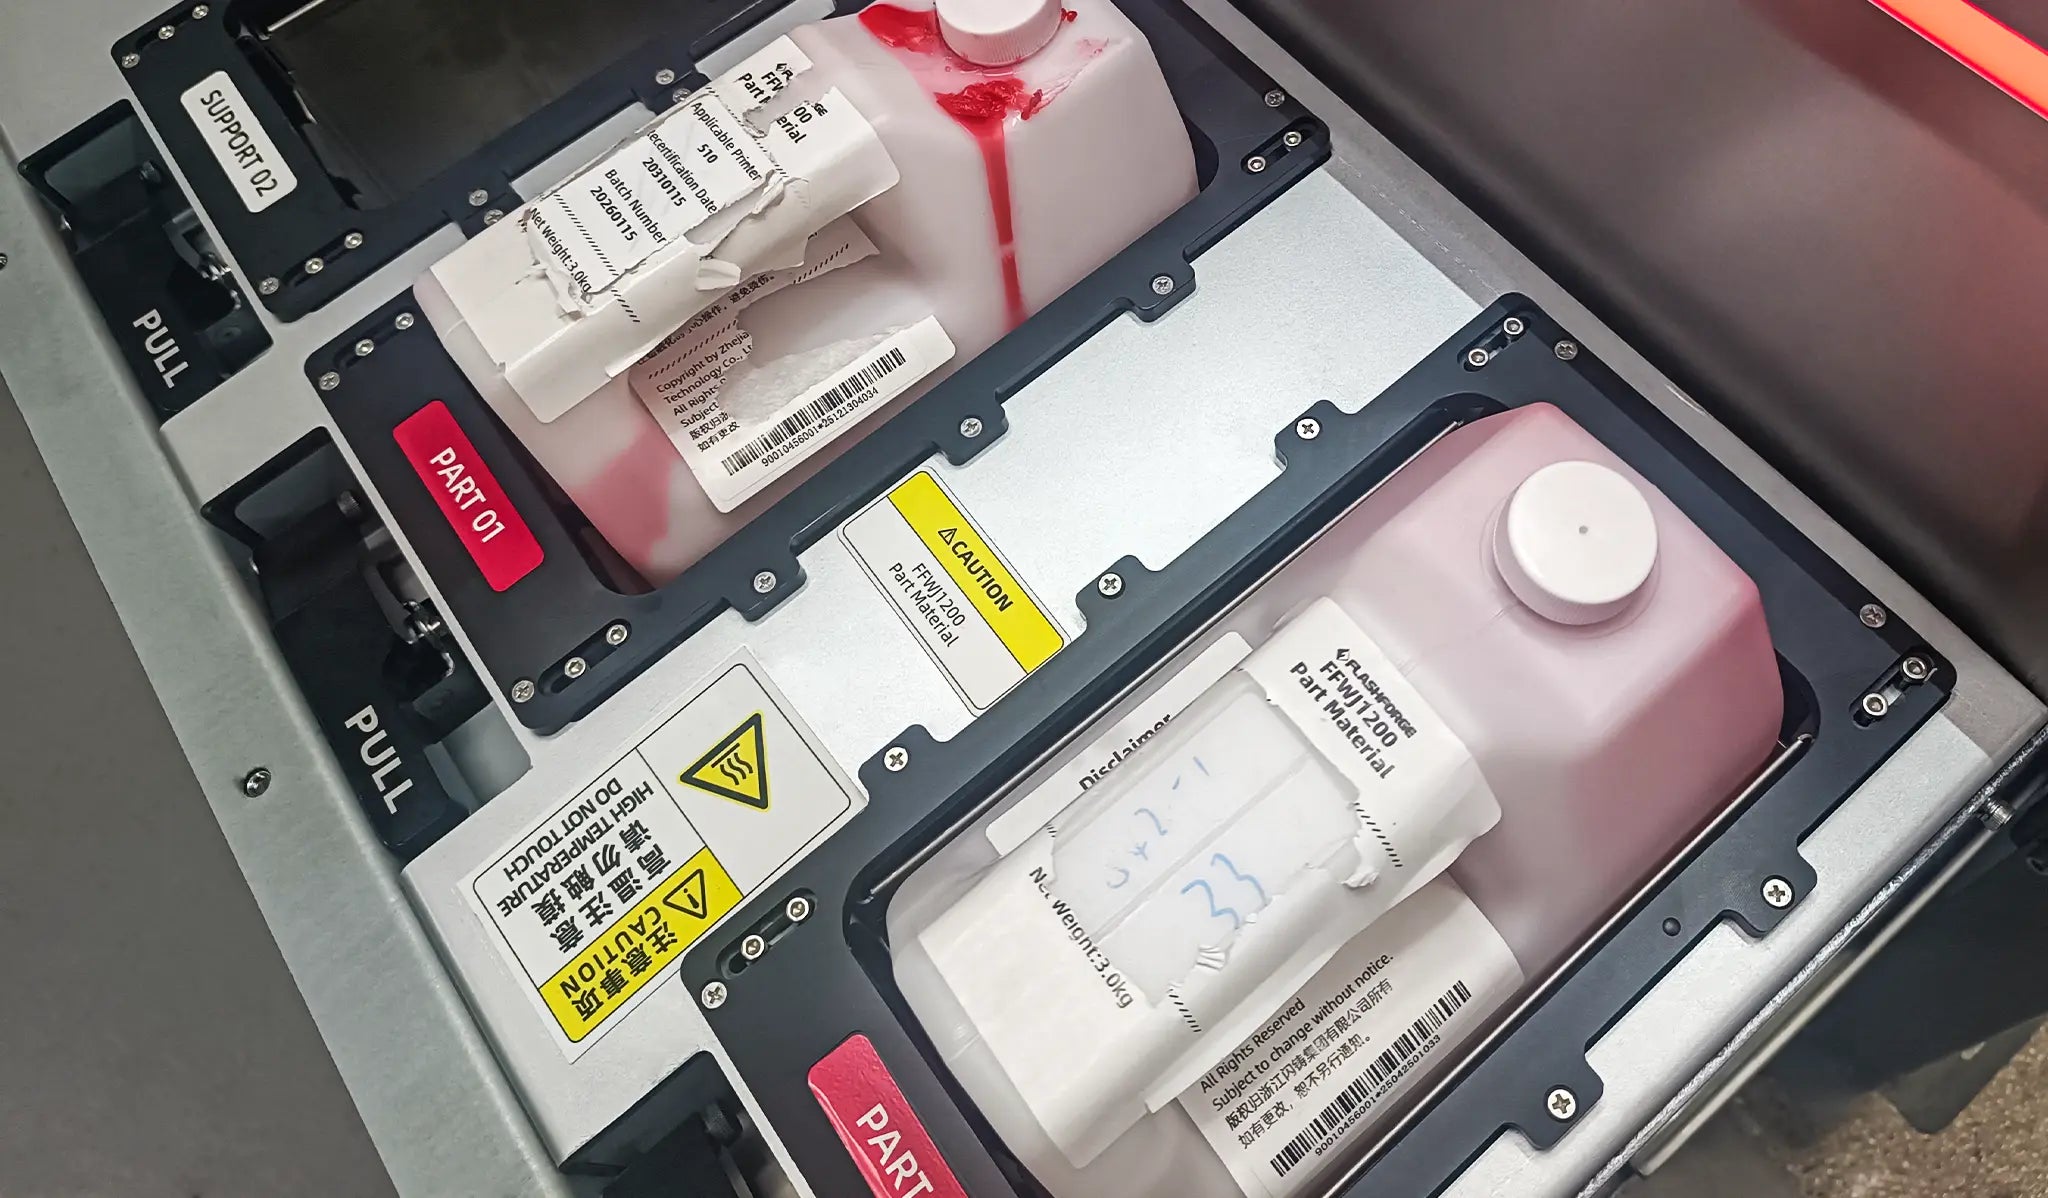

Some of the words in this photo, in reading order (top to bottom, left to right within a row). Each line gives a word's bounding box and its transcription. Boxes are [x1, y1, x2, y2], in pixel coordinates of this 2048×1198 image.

[738, 72, 765, 100] Part
[200, 89, 264, 170] SUPPORT
[250, 168, 279, 198] 02
[642, 156, 687, 208] 20310115
[690, 101, 735, 151] Applicable
[731, 146, 764, 182] Printer
[696, 143, 719, 165] 510
[530, 207, 546, 227] Net
[590, 185, 638, 243] 20260115
[604, 168, 632, 201] Batch
[628, 199, 668, 245] Number
[693, 185, 719, 215] Date
[132, 308, 189, 389] PULL
[656, 358, 706, 394] Copyright
[704, 350, 721, 369] by
[664, 365, 724, 405] Technology
[722, 353, 744, 370] Co.,
[673, 400, 692, 417] All
[680, 401, 720, 428] Subject
[429, 446, 487, 511] PART
[472, 509, 506, 543] 01
[888, 562, 915, 594] Part
[910, 589, 960, 648] Material
[912, 562, 966, 627] FFWJ1200
[951, 540, 1014, 612] CAUTION
[1290, 661, 1330, 703] Part
[1322, 698, 1396, 780] Material
[1319, 659, 1399, 748] FFWJ1200
[1345, 657, 1418, 739] FLASHFORGE
[344, 704, 413, 815] PULL
[594, 777, 624, 805] DO
[562, 801, 597, 837] NOT
[611, 780, 655, 823] HIGH
[496, 816, 614, 918] TEMPERATURE
[503, 829, 563, 882] TOUCH
[531, 819, 652, 928] 请勿触摸
[550, 843, 671, 953] 高温注意
[560, 905, 662, 999] CAUTION
[571, 921, 678, 1022] 注意事项
[1051, 899, 1134, 1009] Weight:3.0kg
[1200, 1076, 1220, 1094] All
[1217, 1045, 1255, 1082] Rights
[1254, 997, 1306, 1046] Reserved
[1212, 1070, 1256, 1112] Subject
[1254, 1059, 1271, 1075] to
[1269, 1023, 1314, 1066] change
[1311, 983, 1357, 1026] without
[1354, 953, 1394, 989] notice.
[1224, 978, 1394, 1131] 版权归浙江闪铸集团有限公司所有
[856, 1103, 934, 1198] PART
